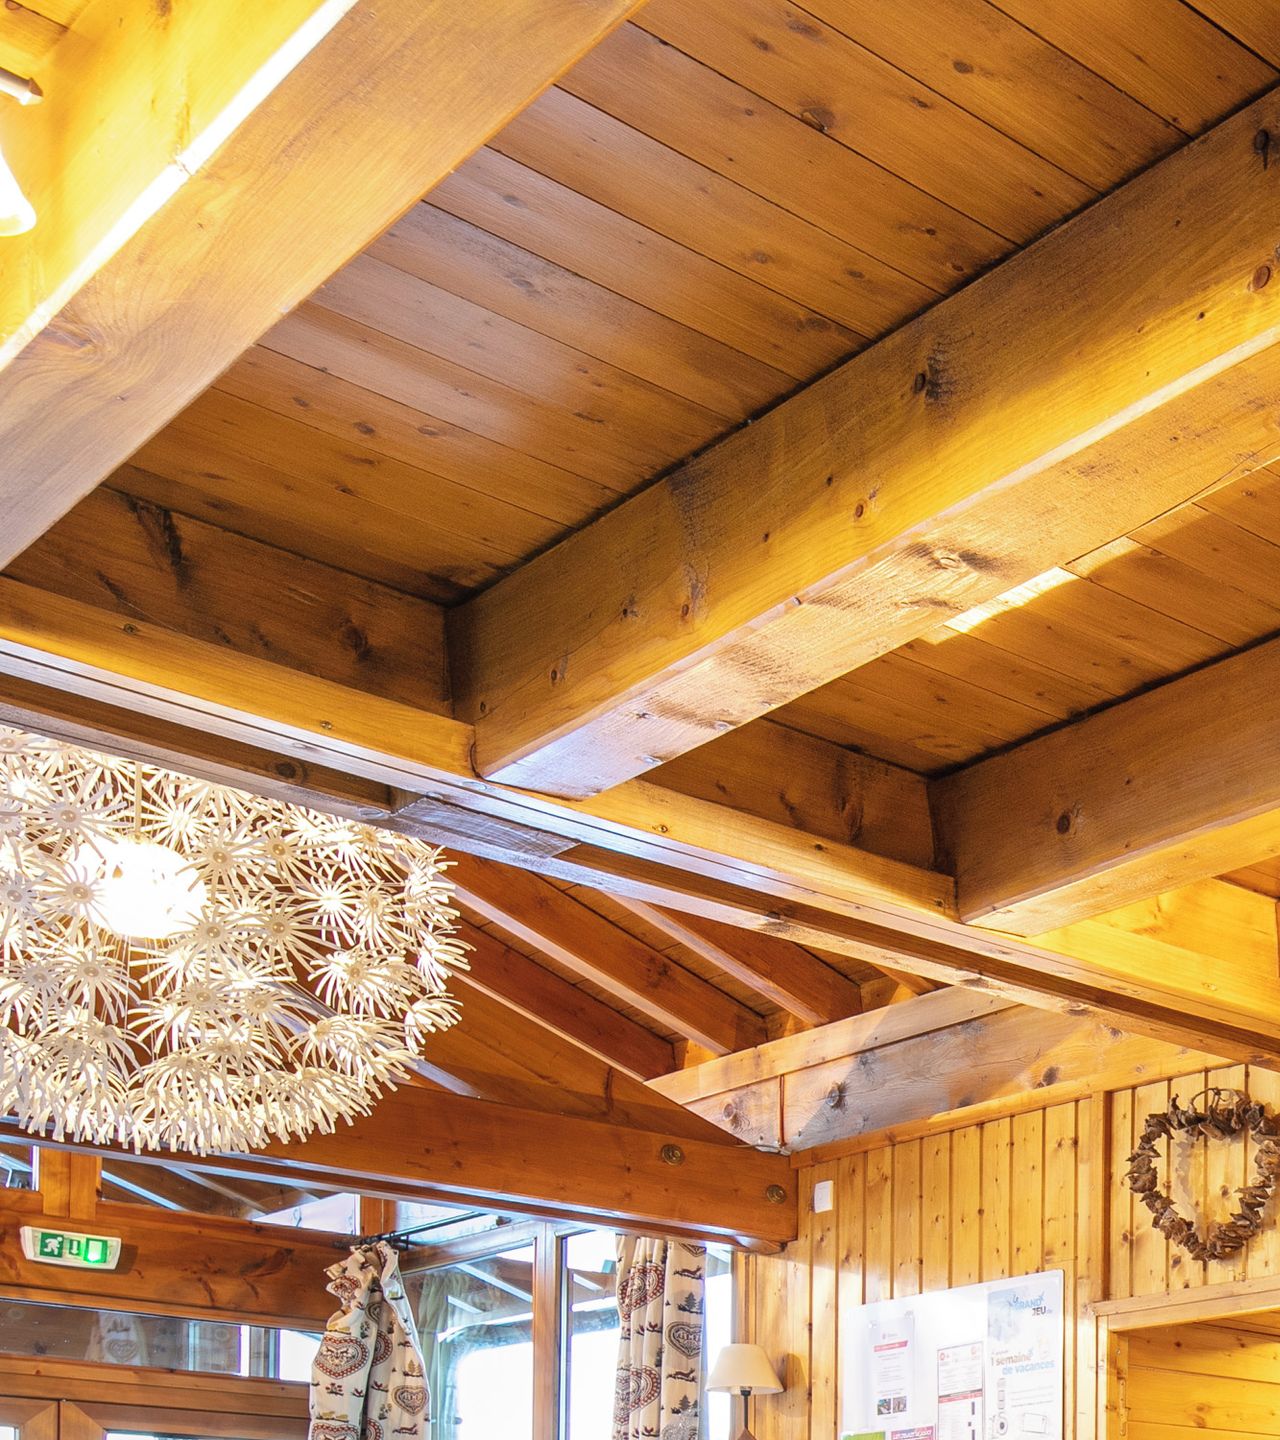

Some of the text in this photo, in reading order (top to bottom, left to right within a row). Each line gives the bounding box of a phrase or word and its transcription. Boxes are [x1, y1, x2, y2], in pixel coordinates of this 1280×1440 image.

[1015, 1298, 1042, 1310] GRAND
[1032, 1306, 1047, 1316] JEU
[996, 1352, 1032, 1367] semaine
[1002, 1359, 1055, 1376] de vacances
